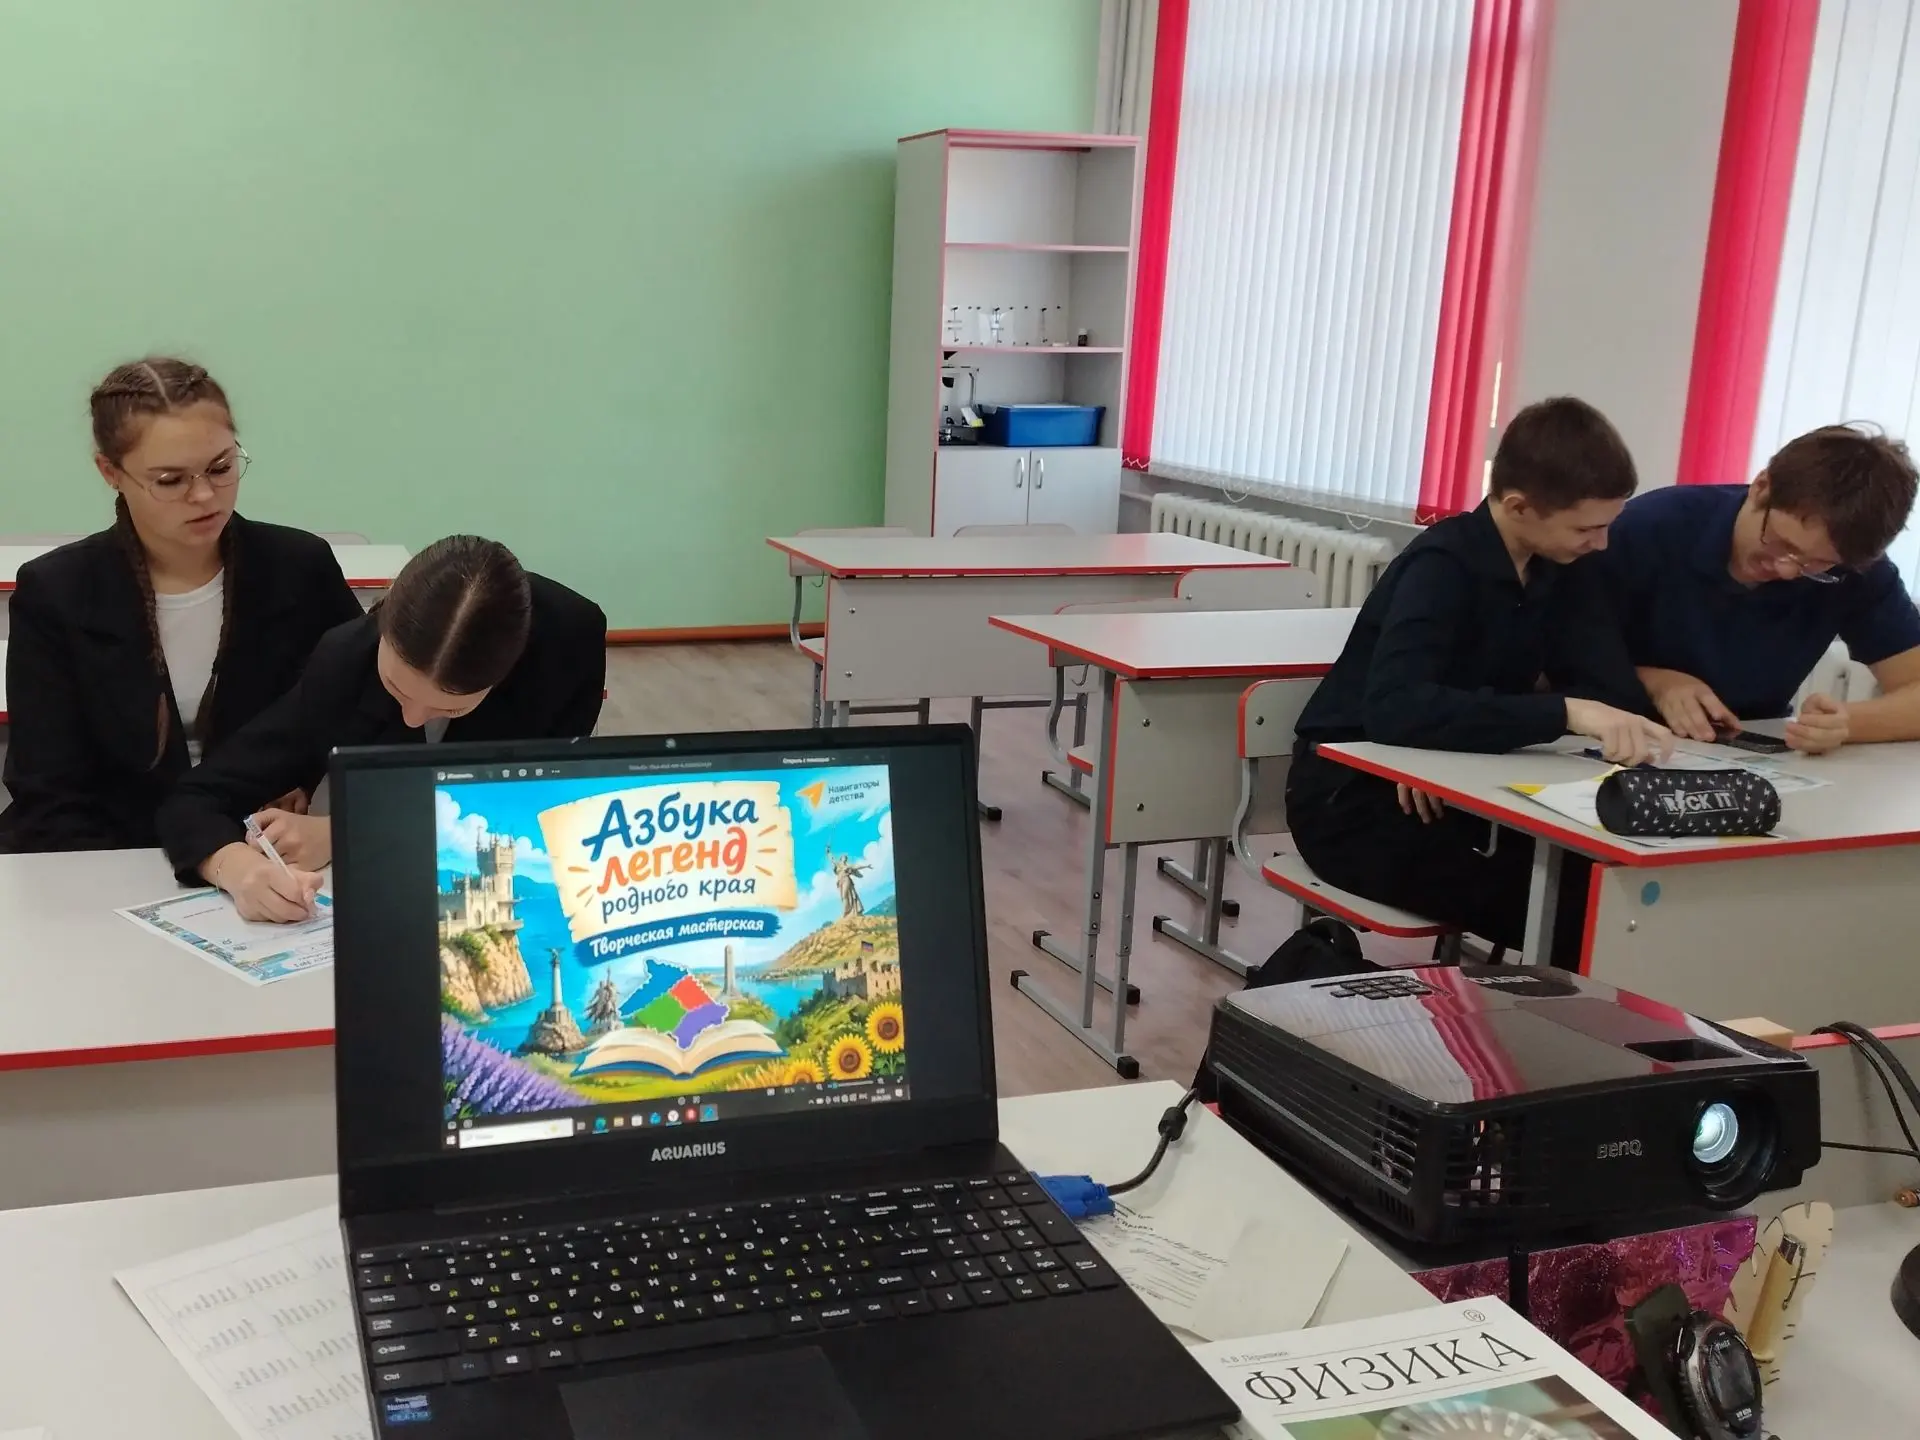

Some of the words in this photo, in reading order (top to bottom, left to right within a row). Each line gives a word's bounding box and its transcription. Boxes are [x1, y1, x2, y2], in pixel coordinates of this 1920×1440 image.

[829, 781, 880, 795] Навигаторы
[829, 792, 865, 804] детства
[1714, 791, 1733, 806] IT
[582, 792, 759, 862] Азбука
[598, 826, 748, 895] легенд
[602, 880, 688, 923] родного
[699, 876, 756, 903] края
[590, 925, 675, 957] Творческая
[677, 916, 765, 939] мастерская
[651, 1142, 726, 1162] AQUARIUS
[1597, 1139, 1643, 1160] BenQ
[743, 1241, 755, 1250] O
[629, 1256, 639, 1265] Y
[667, 1251, 678, 1260] U
[590, 1261, 600, 1270] T
[763, 1262, 774, 1271] L
[510, 1272, 522, 1281] E
[550, 1267, 562, 1276] R
[725, 1267, 737, 1276] K
[470, 1277, 484, 1286] W
[528, 1294, 540, 1303] D
[712, 1293, 726, 1303] M
[673, 1299, 685, 1308] N
[446, 1305, 457, 1315] A
[592, 1310, 603, 1320] V
[551, 1315, 564, 1326] C
[509, 1321, 521, 1331] X
[467, 1327, 478, 1338] Z
[1245, 1331, 1538, 1405] ФИЗИКА
[383, 1372, 401, 1381] Ctrl
